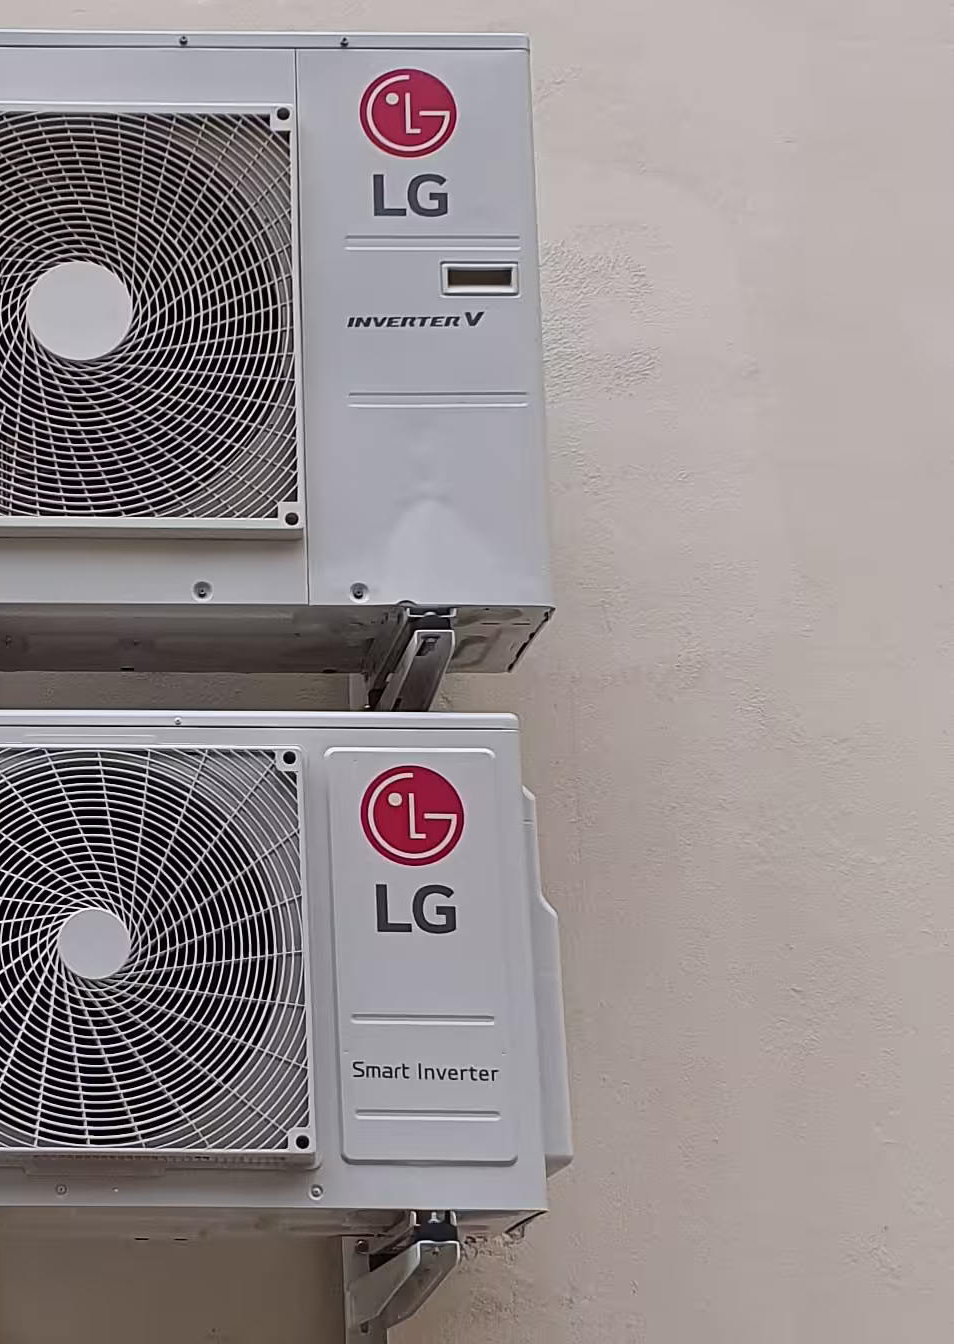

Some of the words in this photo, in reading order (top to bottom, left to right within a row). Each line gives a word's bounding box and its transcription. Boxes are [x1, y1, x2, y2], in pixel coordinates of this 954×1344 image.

[372, 173, 449, 218] LG
[347, 316, 460, 328] INVERTER
[375, 884, 457, 934] LG
[352, 1061, 410, 1080] Smart
[417, 1063, 500, 1083] Inverter
